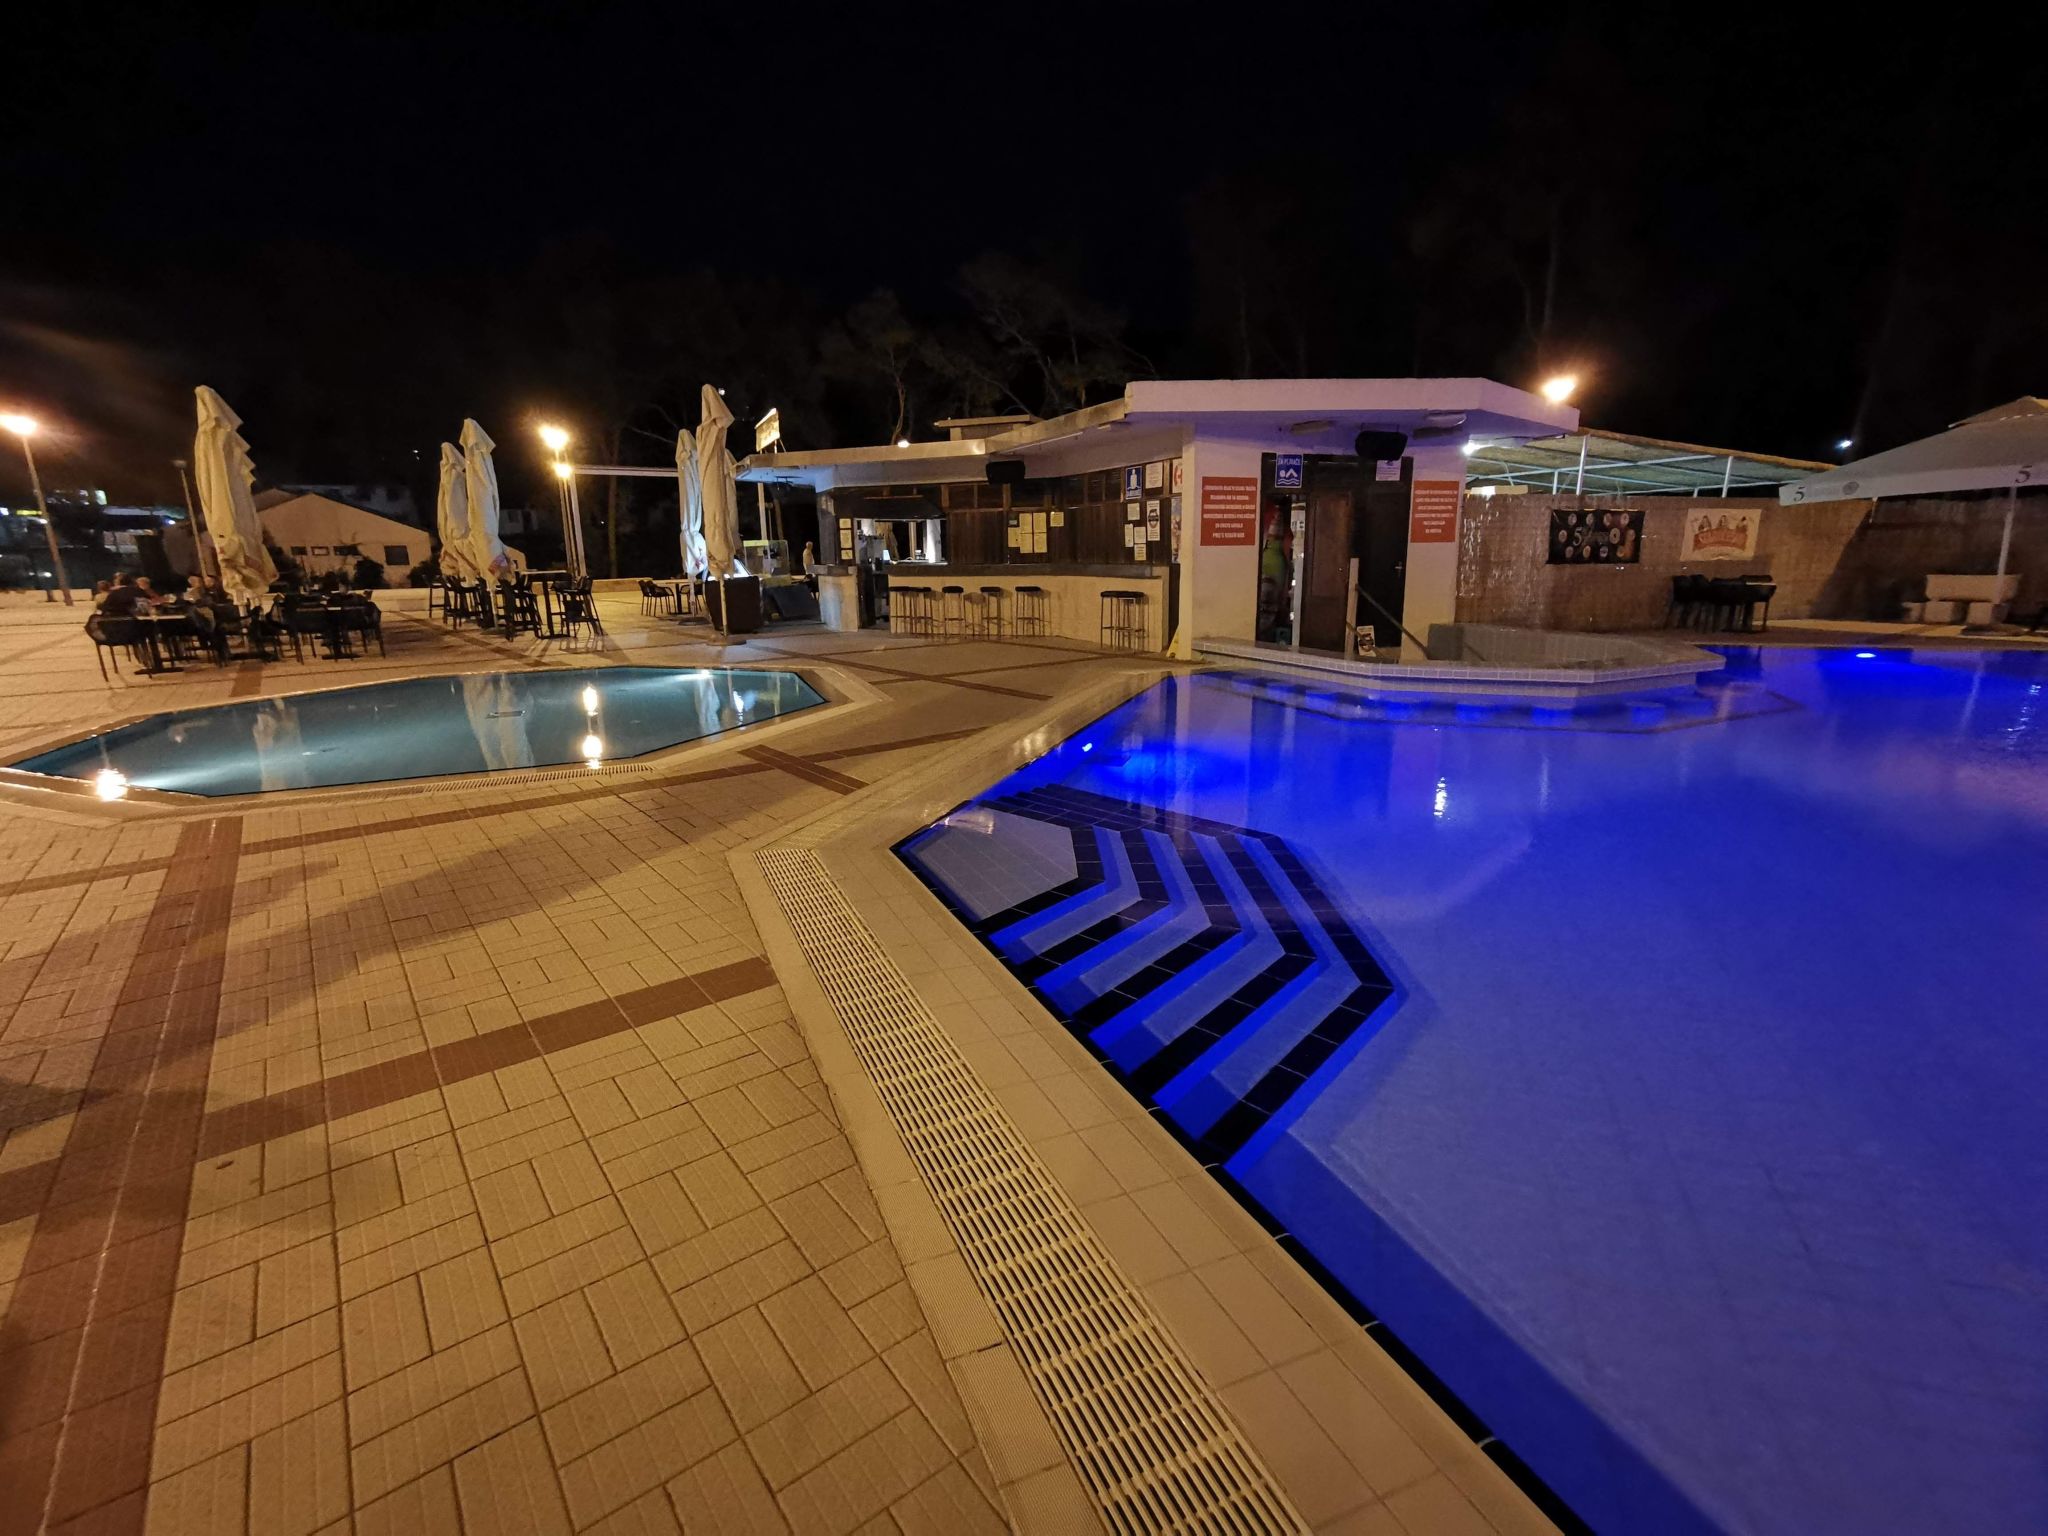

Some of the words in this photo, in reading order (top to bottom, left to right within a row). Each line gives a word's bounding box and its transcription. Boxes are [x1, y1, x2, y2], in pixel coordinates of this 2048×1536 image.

[2015, 465, 2033, 484] 5
[1793, 486, 1806, 502] 5
[1572, 526, 1584, 546] 5
